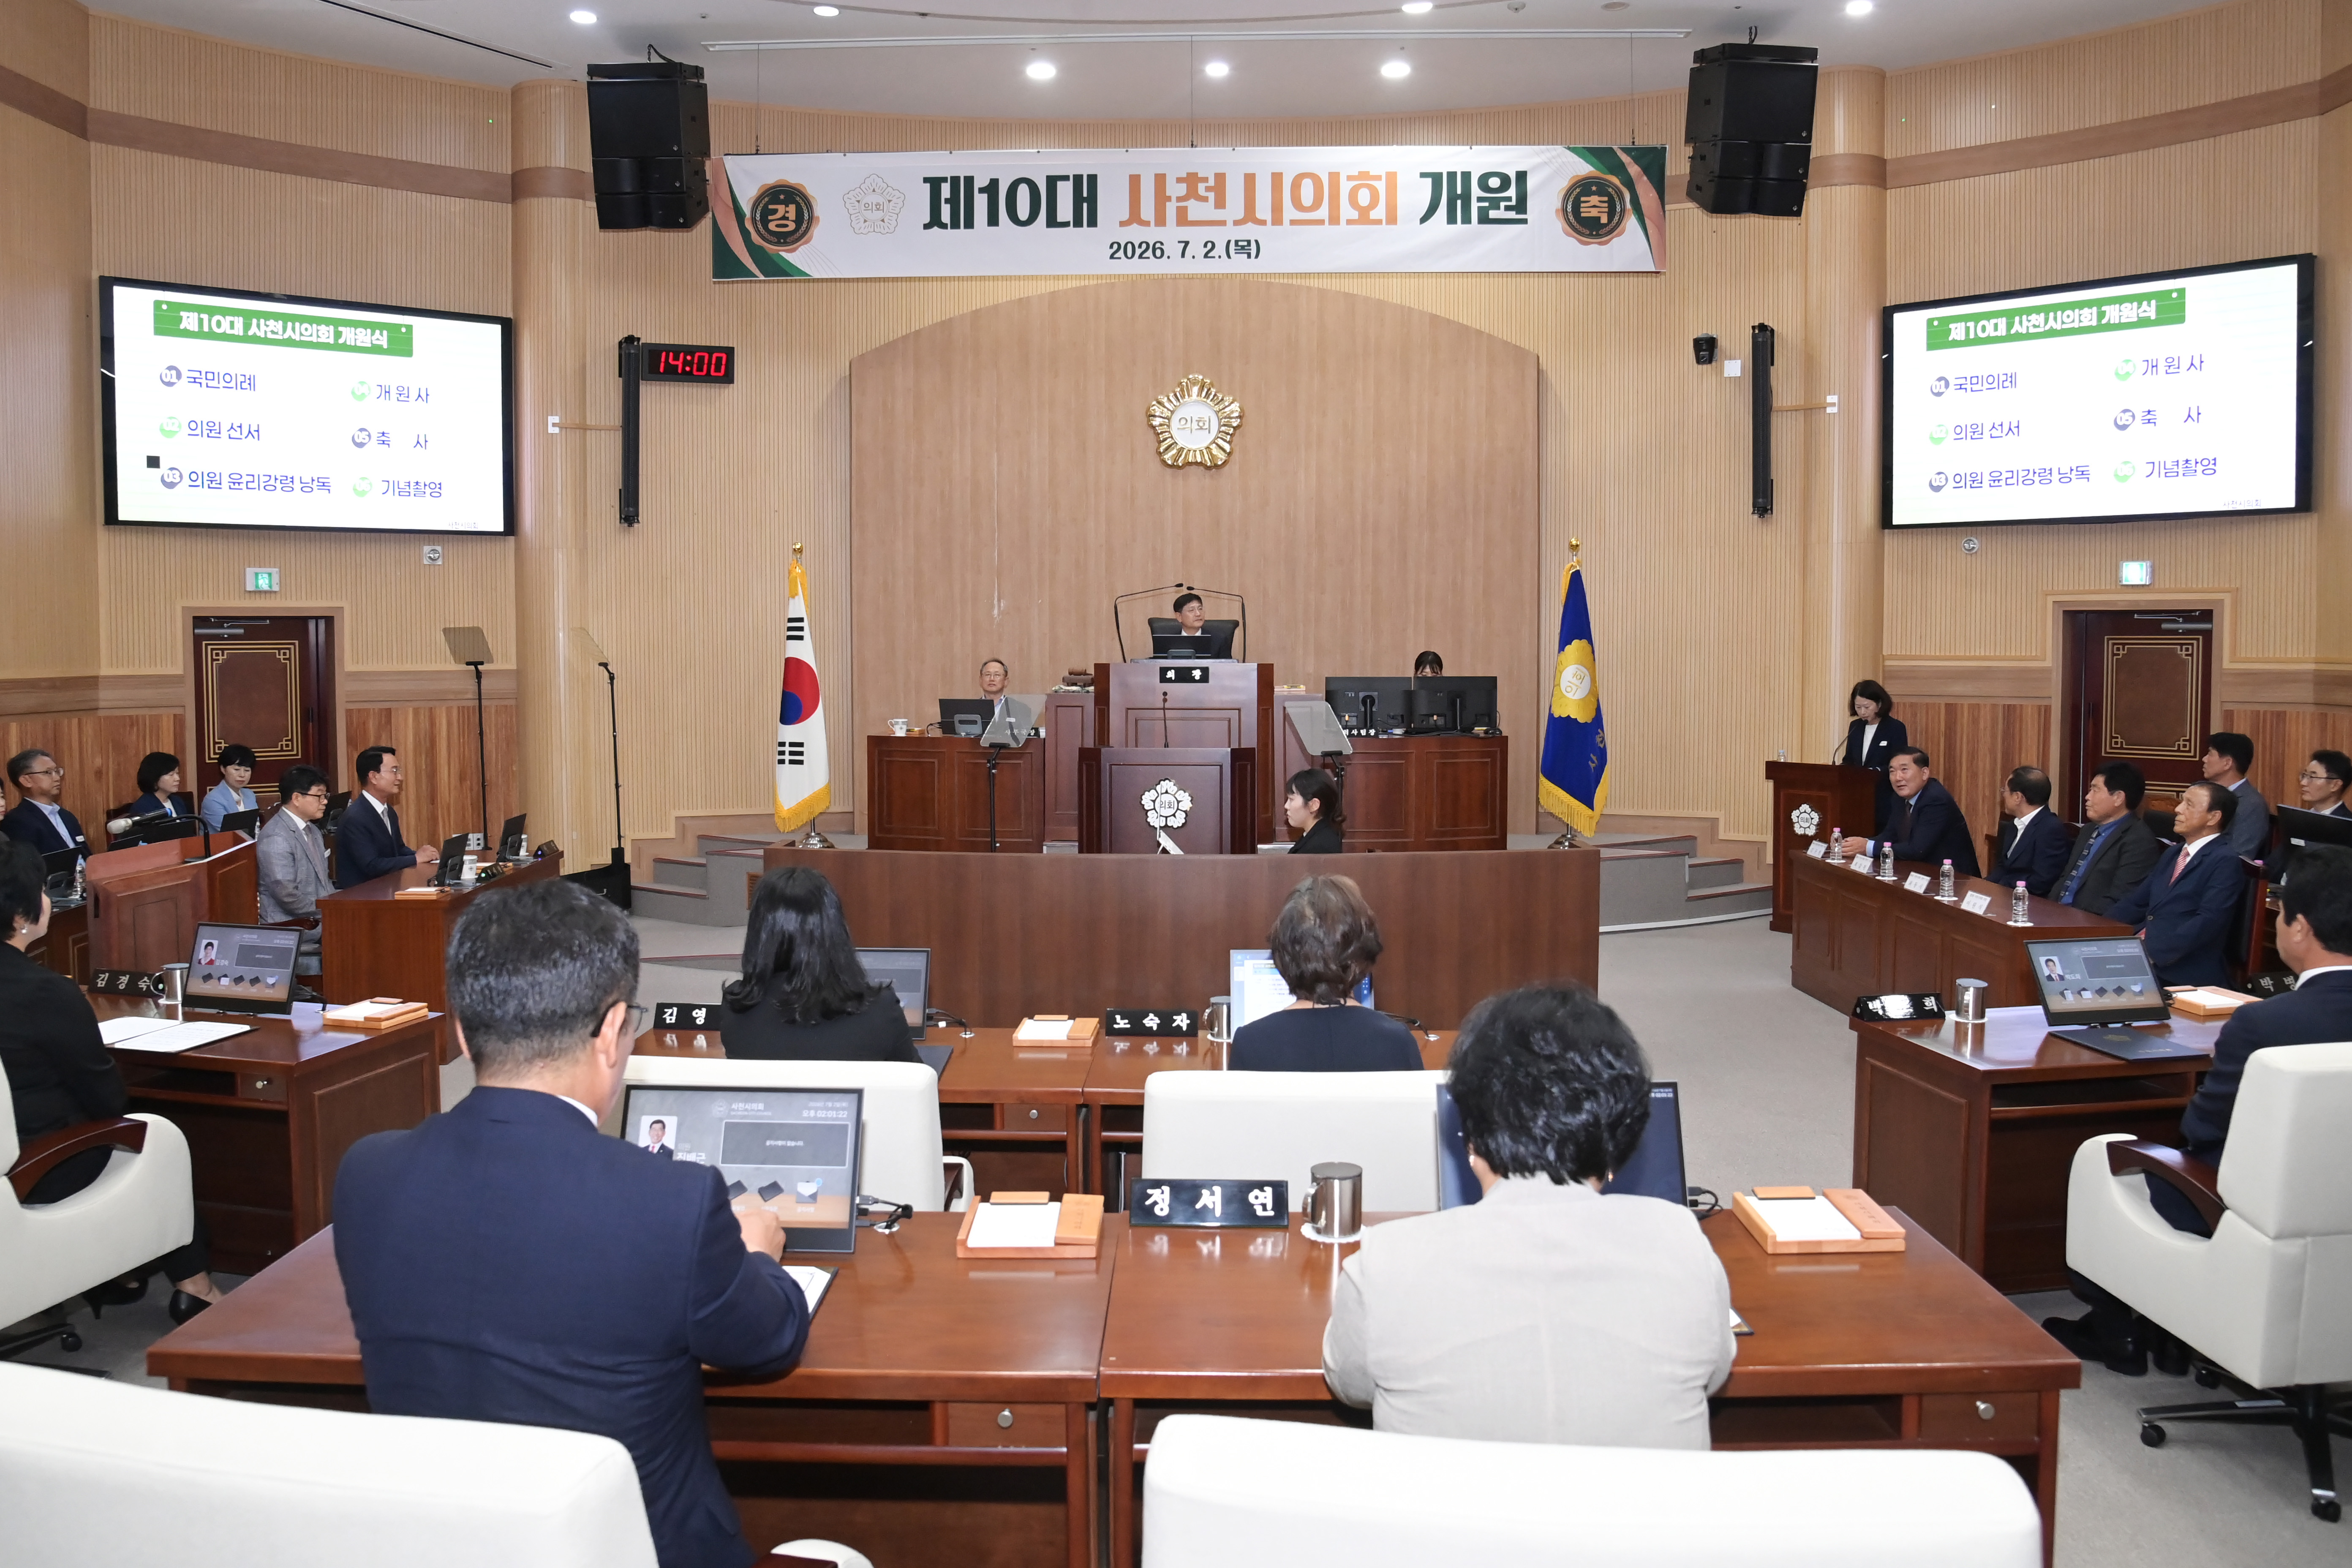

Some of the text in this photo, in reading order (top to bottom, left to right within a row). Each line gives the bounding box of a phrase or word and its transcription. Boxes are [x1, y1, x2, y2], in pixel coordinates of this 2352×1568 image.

[863, 201, 885, 213] 의회
[922, 170, 1529, 230] 제10대 사천시의회 개원
[1580, 195, 1609, 223] 축
[768, 204, 796, 231] 경
[1109, 240, 1171, 260] 2026.
[1177, 240, 1195, 259] 7.
[180, 311, 388, 348] 제10대 사천시의회 개원식
[1948, 300, 2156, 341] 제10대 사천시의회 개원식
[659, 351, 727, 376] 14:00
[161, 369, 255, 391] 01 국민의례
[1932, 372, 2016, 393] 01 국민의례
[1176, 415, 1211, 434] 의회
[2116, 412, 2133, 425] 05
[188, 420, 221, 438] 의원
[227, 423, 259, 441] 선서
[354, 431, 369, 443] 05
[1954, 423, 1983, 440] 의원
[1989, 420, 2019, 438] 선서
[1932, 466, 2090, 489] 03 의원 윤리강령 낭독
[2146, 457, 2216, 478] 기념촬영
[164, 470, 331, 493] 03 의원 윤리강령 낭독
[382, 480, 441, 498] 기념촬영
[2223, 499, 2261, 509] 사천시의회
[448, 521, 478, 529] 사천시의회
